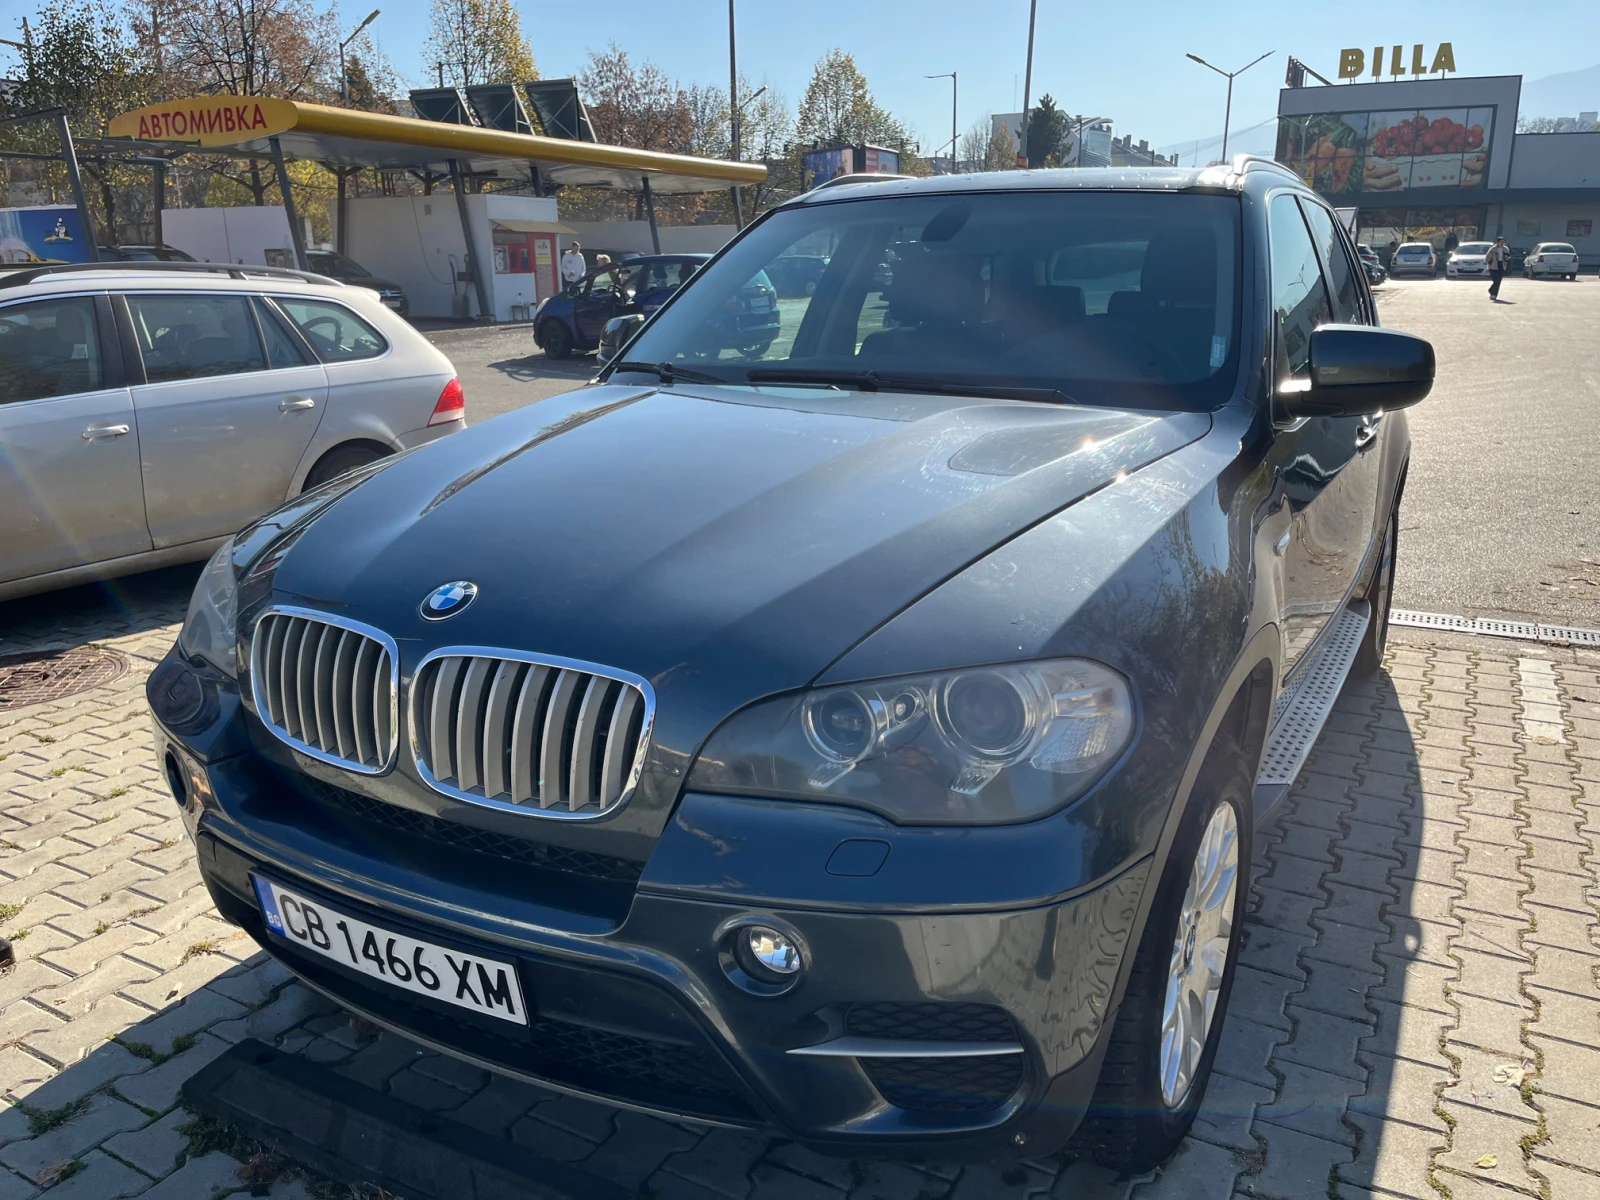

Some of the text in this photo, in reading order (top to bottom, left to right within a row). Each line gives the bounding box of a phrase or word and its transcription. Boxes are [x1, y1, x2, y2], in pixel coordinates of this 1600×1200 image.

[1338, 42, 1456, 79] BILLA
[138, 103, 267, 139] АВТОМИВКА
[266, 910, 282, 927] BG
[279, 894, 516, 1015] CB 1466 XM
